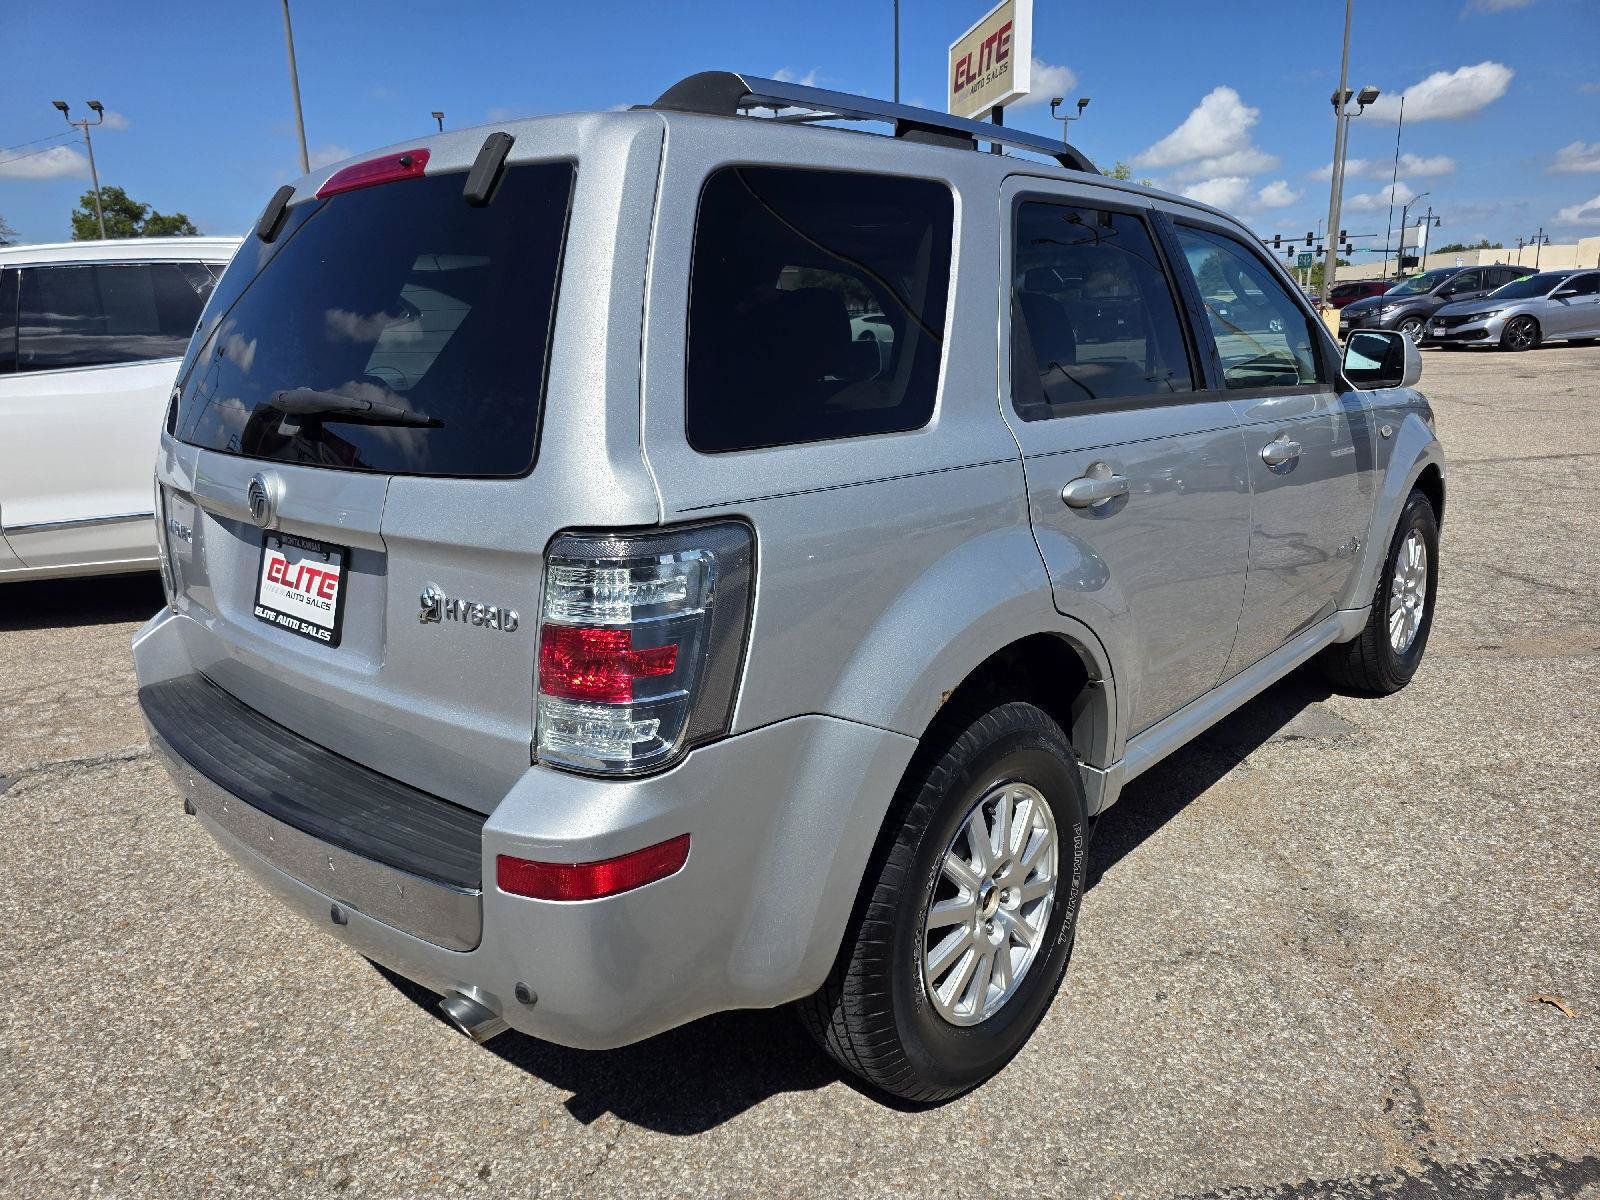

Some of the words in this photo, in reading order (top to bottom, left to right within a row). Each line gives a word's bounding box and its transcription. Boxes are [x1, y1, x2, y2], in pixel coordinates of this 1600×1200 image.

[954, 20, 1012, 93] ELITE
[970, 78, 985, 95] AUTO
[986, 61, 1009, 85] SALES
[267, 557, 340, 601] ELITE
[285, 590, 305, 603] AUTO
[306, 597, 332, 611] SALES
[445, 599, 520, 632] HYBRID
[254, 606, 277, 621] ELITE
[276, 614, 300, 630] AUTO
[300, 623, 332, 641] SALES
